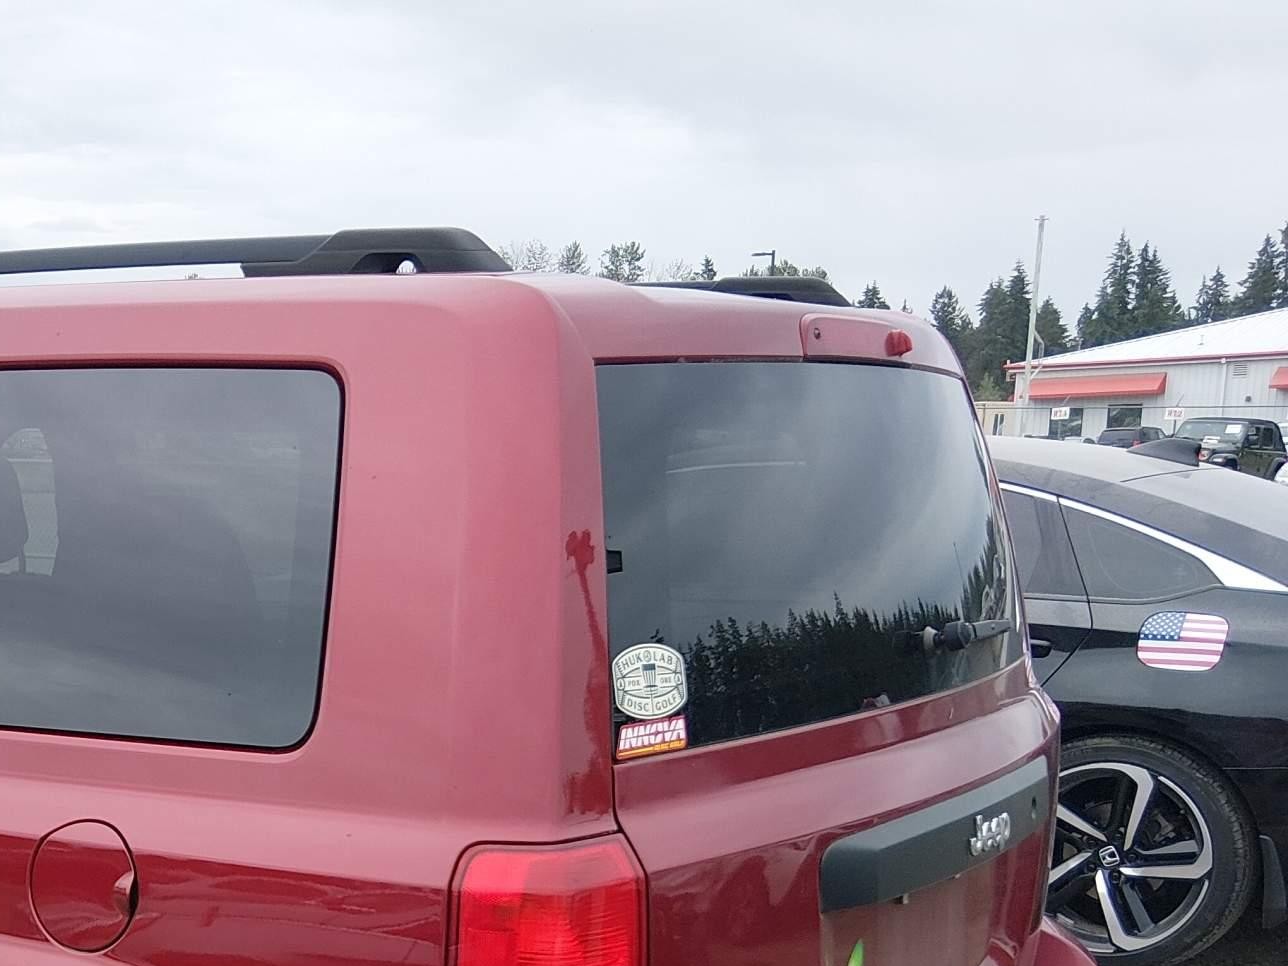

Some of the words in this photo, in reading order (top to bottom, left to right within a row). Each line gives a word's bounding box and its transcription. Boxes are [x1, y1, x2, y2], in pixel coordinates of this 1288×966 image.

[626, 697, 650, 712] DISC
[654, 692, 678, 711] GOLF
[618, 718, 686, 751] INNOVA
[969, 811, 1011, 857] Jeep
